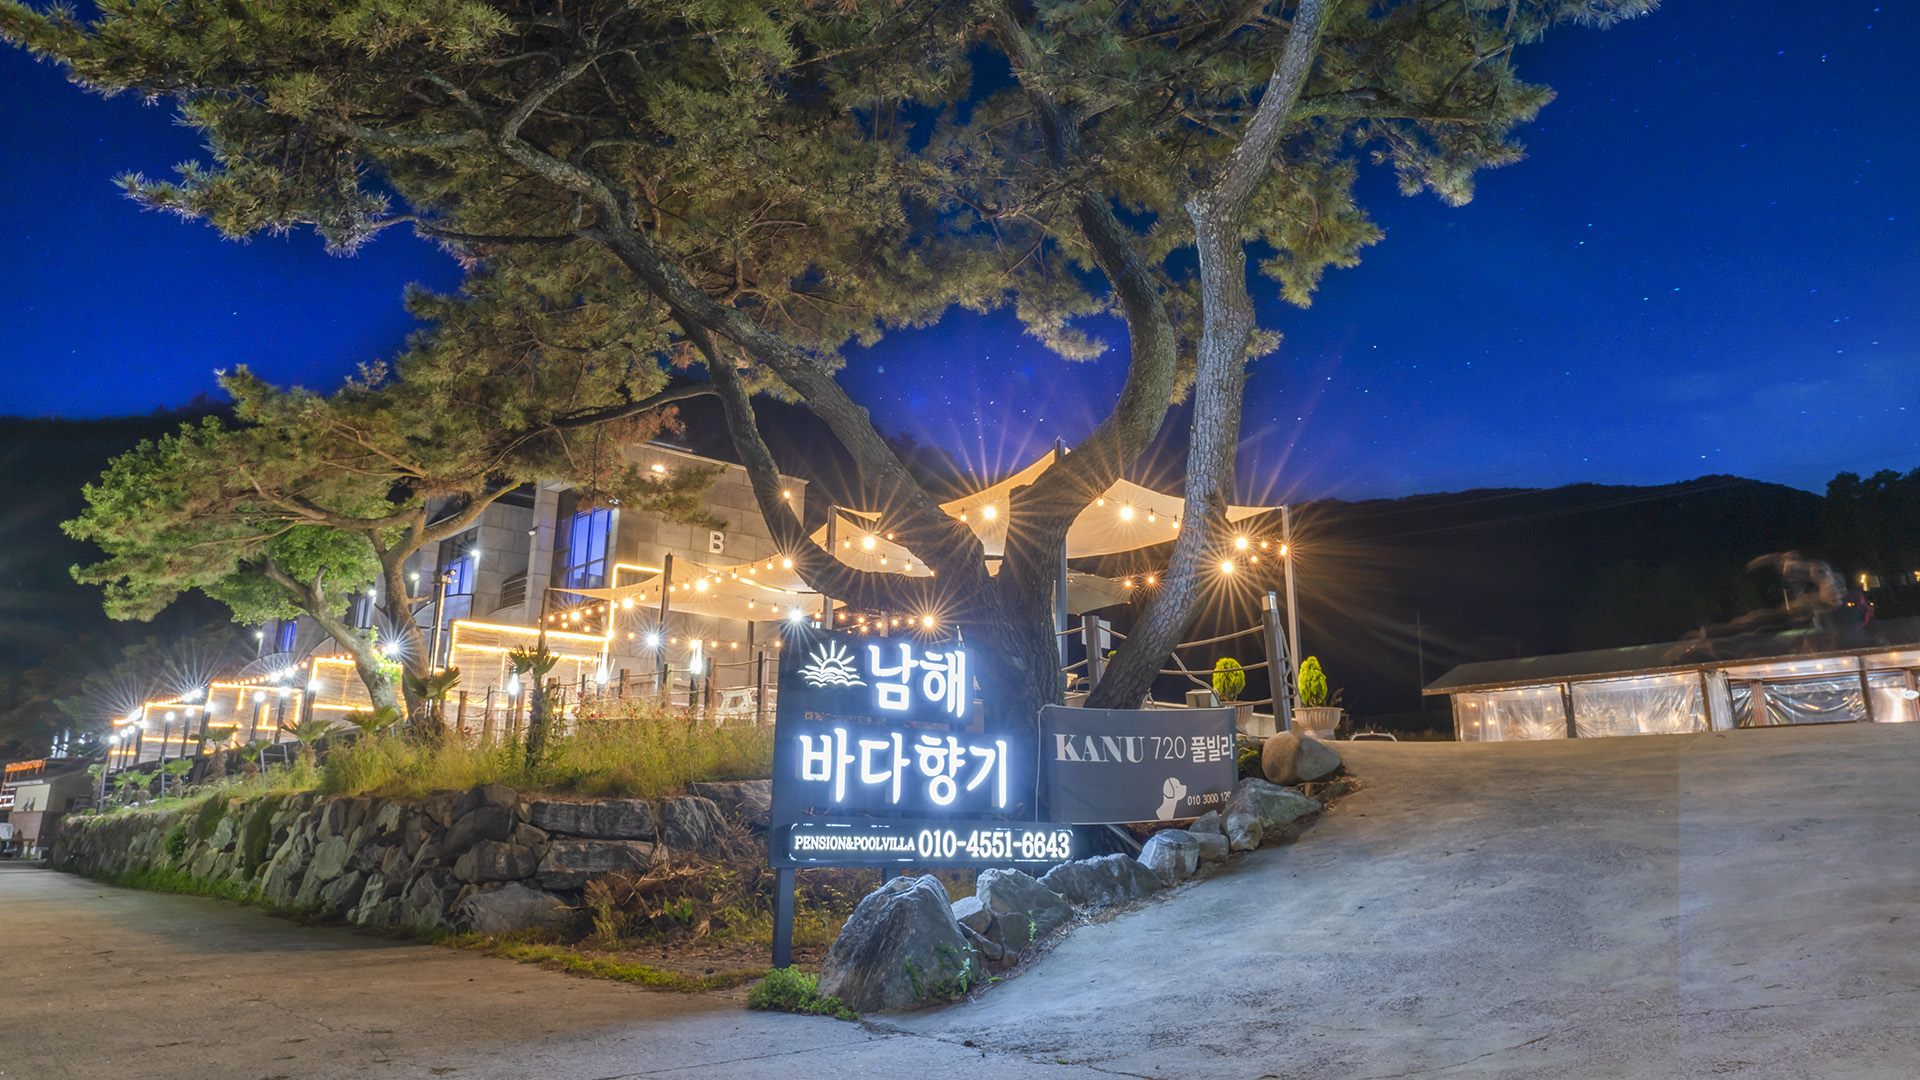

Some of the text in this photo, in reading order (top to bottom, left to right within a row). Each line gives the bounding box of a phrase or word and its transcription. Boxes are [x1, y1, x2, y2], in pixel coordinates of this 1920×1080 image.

[709, 530, 725, 554] B
[868, 643, 967, 718] 남해
[1053, 733, 1236, 763] KANU 720 풀빌라
[799, 727, 1007, 808] 바다향기
[1187, 795, 1201, 806] 010
[795, 829, 1071, 859] PENSION&POOLVILLA 010-4551-6643
